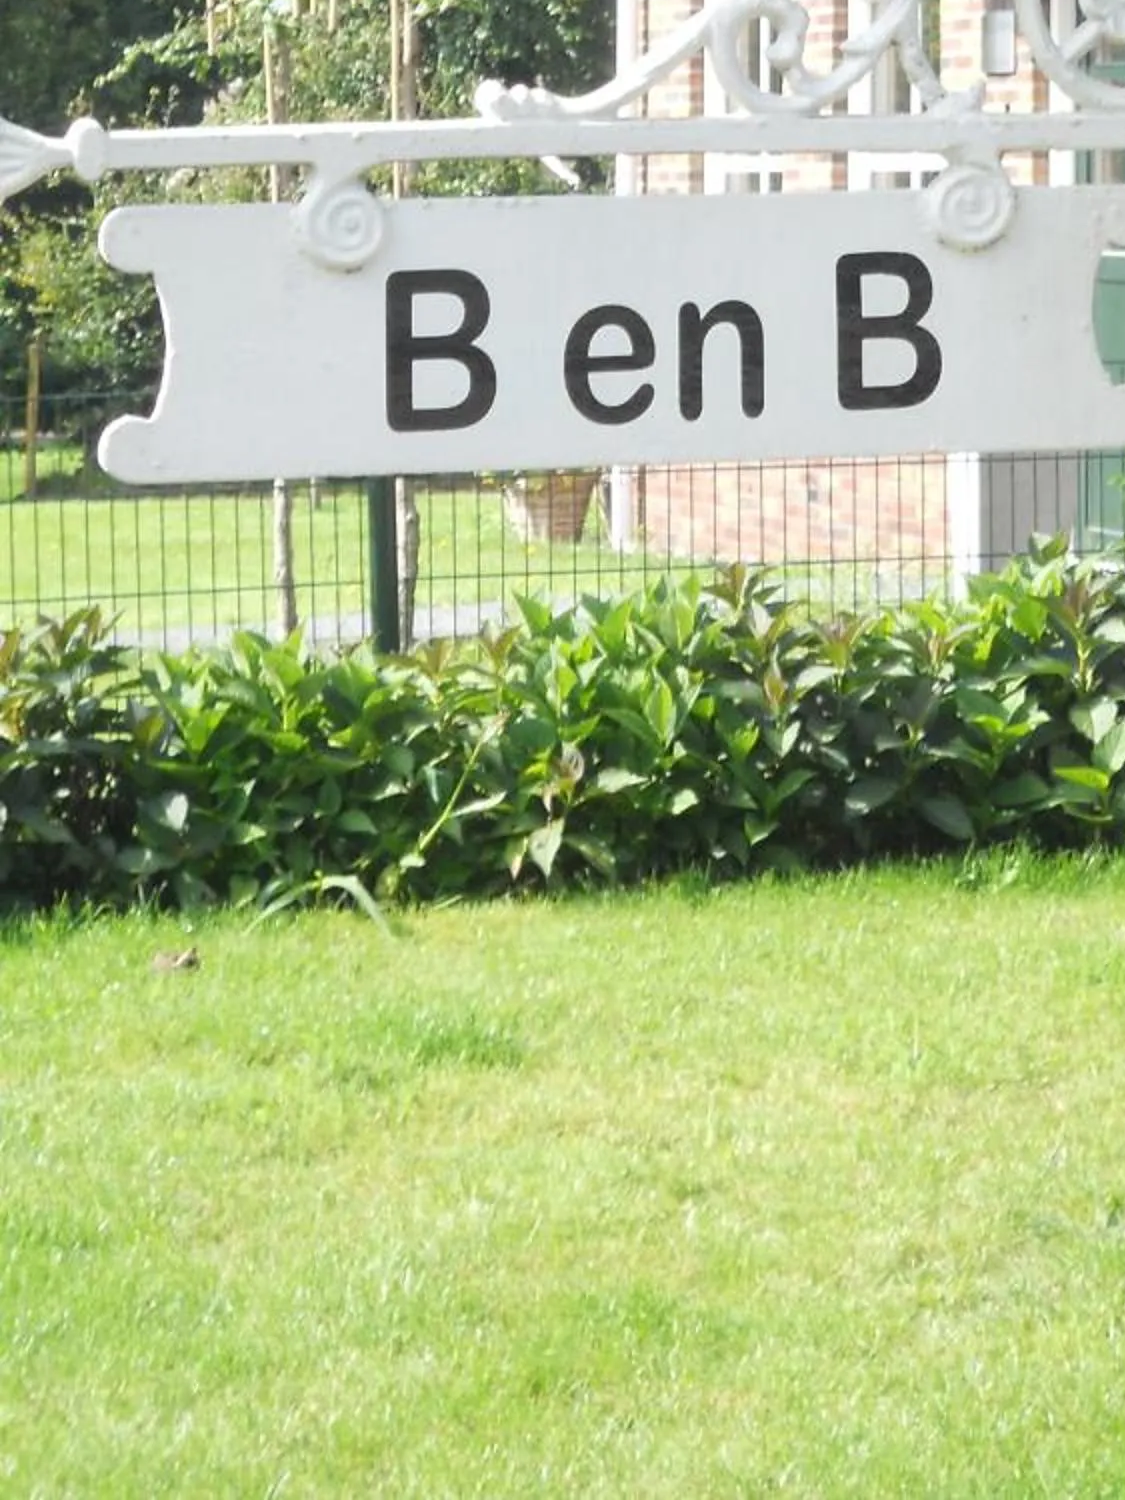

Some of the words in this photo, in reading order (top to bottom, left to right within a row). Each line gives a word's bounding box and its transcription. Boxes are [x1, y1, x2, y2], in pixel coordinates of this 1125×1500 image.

[386, 269, 497, 432] B
[564, 300, 765, 425] en
[836, 252, 942, 410] B
